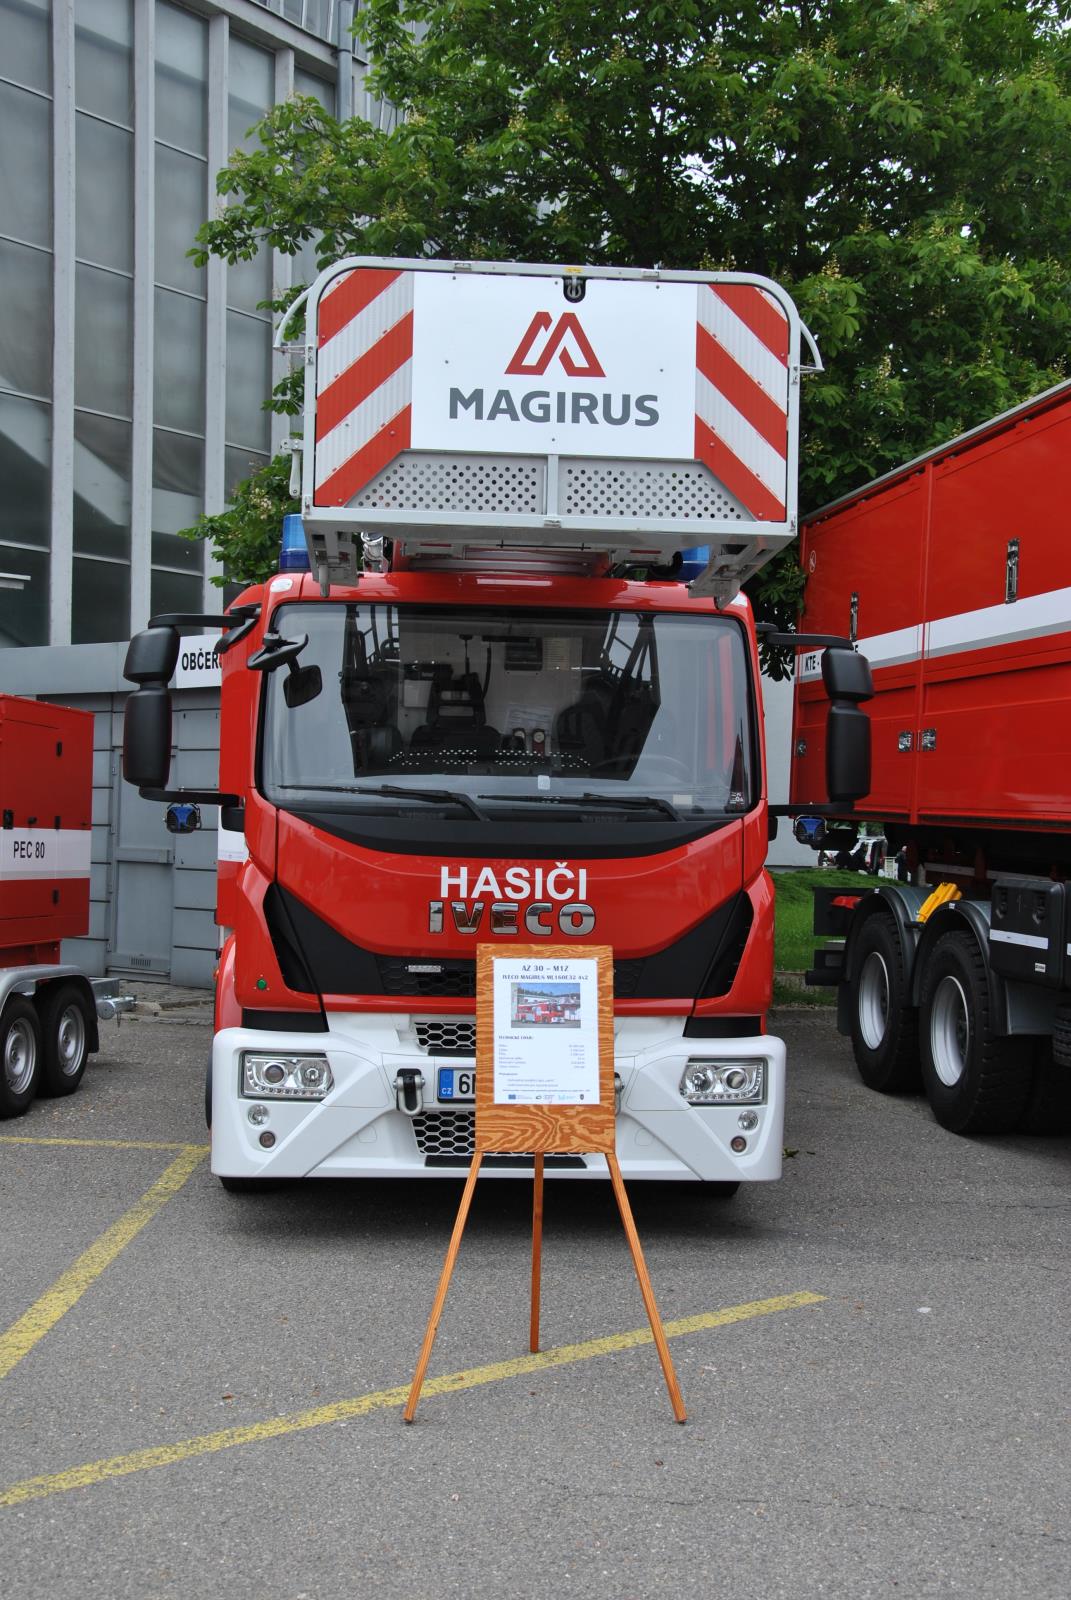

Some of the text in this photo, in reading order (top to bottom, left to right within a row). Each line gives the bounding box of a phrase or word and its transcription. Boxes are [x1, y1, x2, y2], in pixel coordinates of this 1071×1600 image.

[449, 387, 660, 427] MAGIRUS
[181, 648, 222, 671] OBČER
[13, 840, 45, 859] PEC 80
[440, 861, 587, 901] HASIČI
[428, 901, 597, 936] IVECO
[521, 964, 532, 972] AZ
[441, 1087, 452, 1095] CZ
